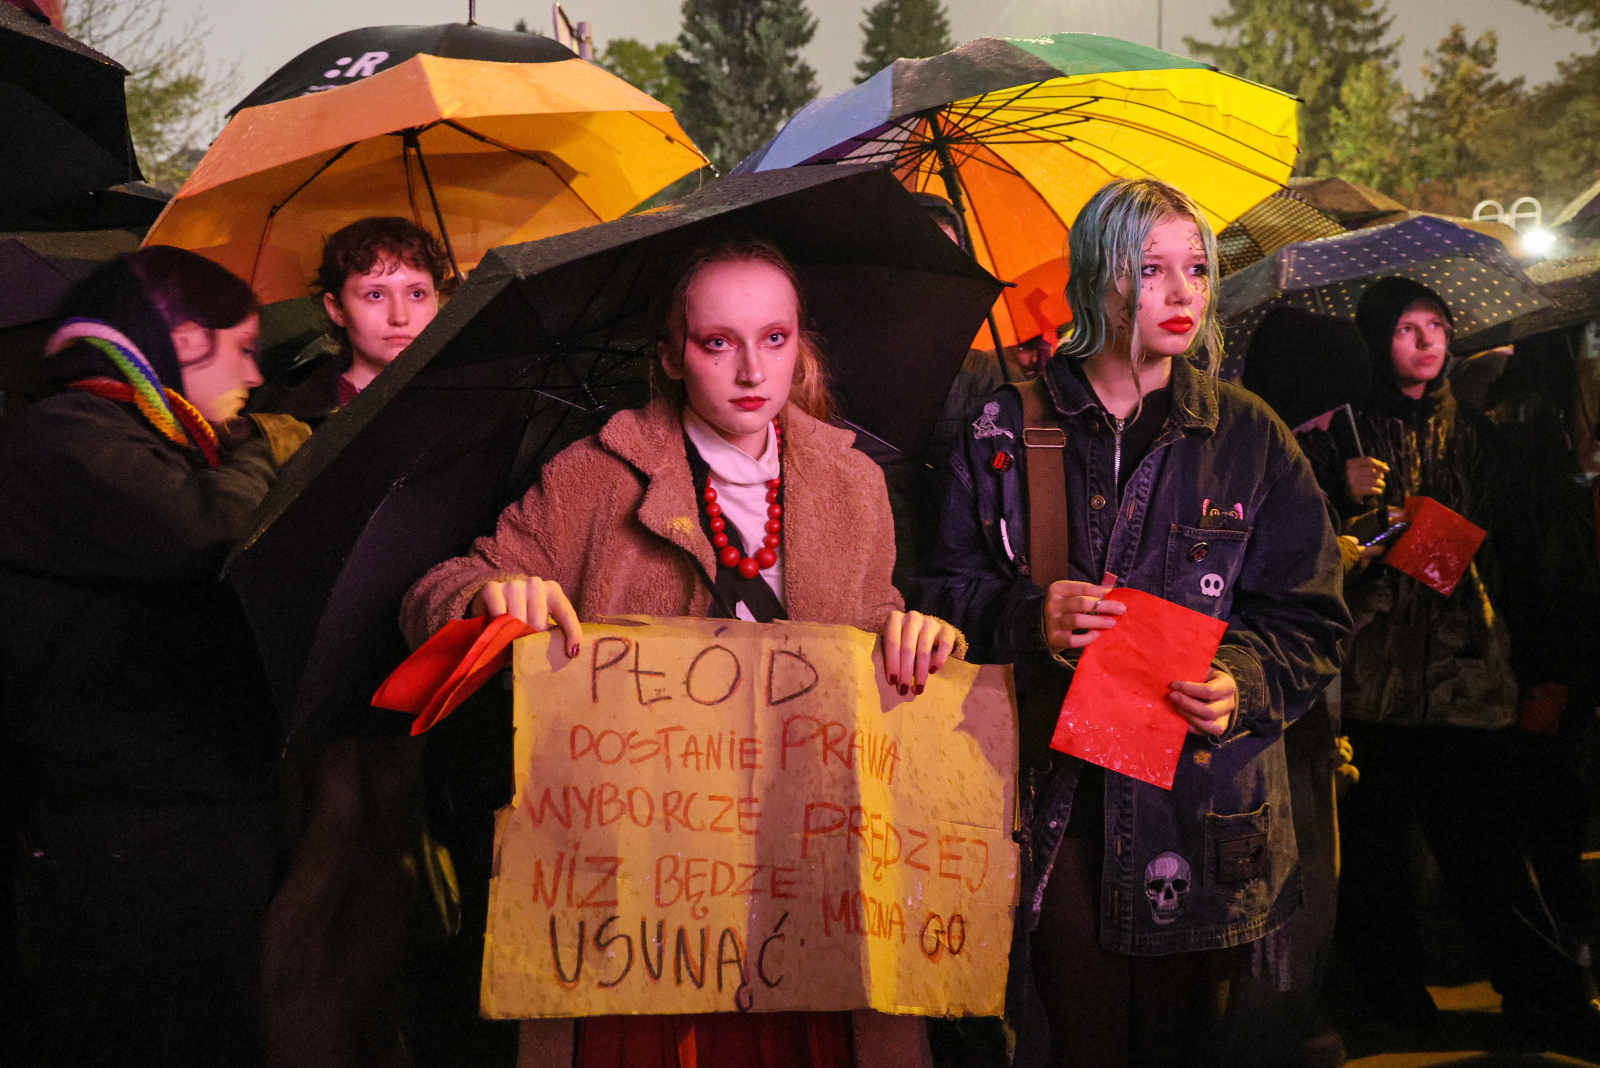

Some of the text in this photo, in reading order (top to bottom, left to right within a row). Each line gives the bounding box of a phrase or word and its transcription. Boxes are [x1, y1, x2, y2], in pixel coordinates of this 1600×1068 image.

[591, 627, 819, 706] PŁÓD
[780, 714, 901, 785] PRAWA
[525, 783, 990, 894] WYBORCZE PRĘDZEJ
[654, 855, 798, 919] BĘDZE
[920, 912, 966, 964] GO
[549, 911, 790, 1012] USUNĄĆ
